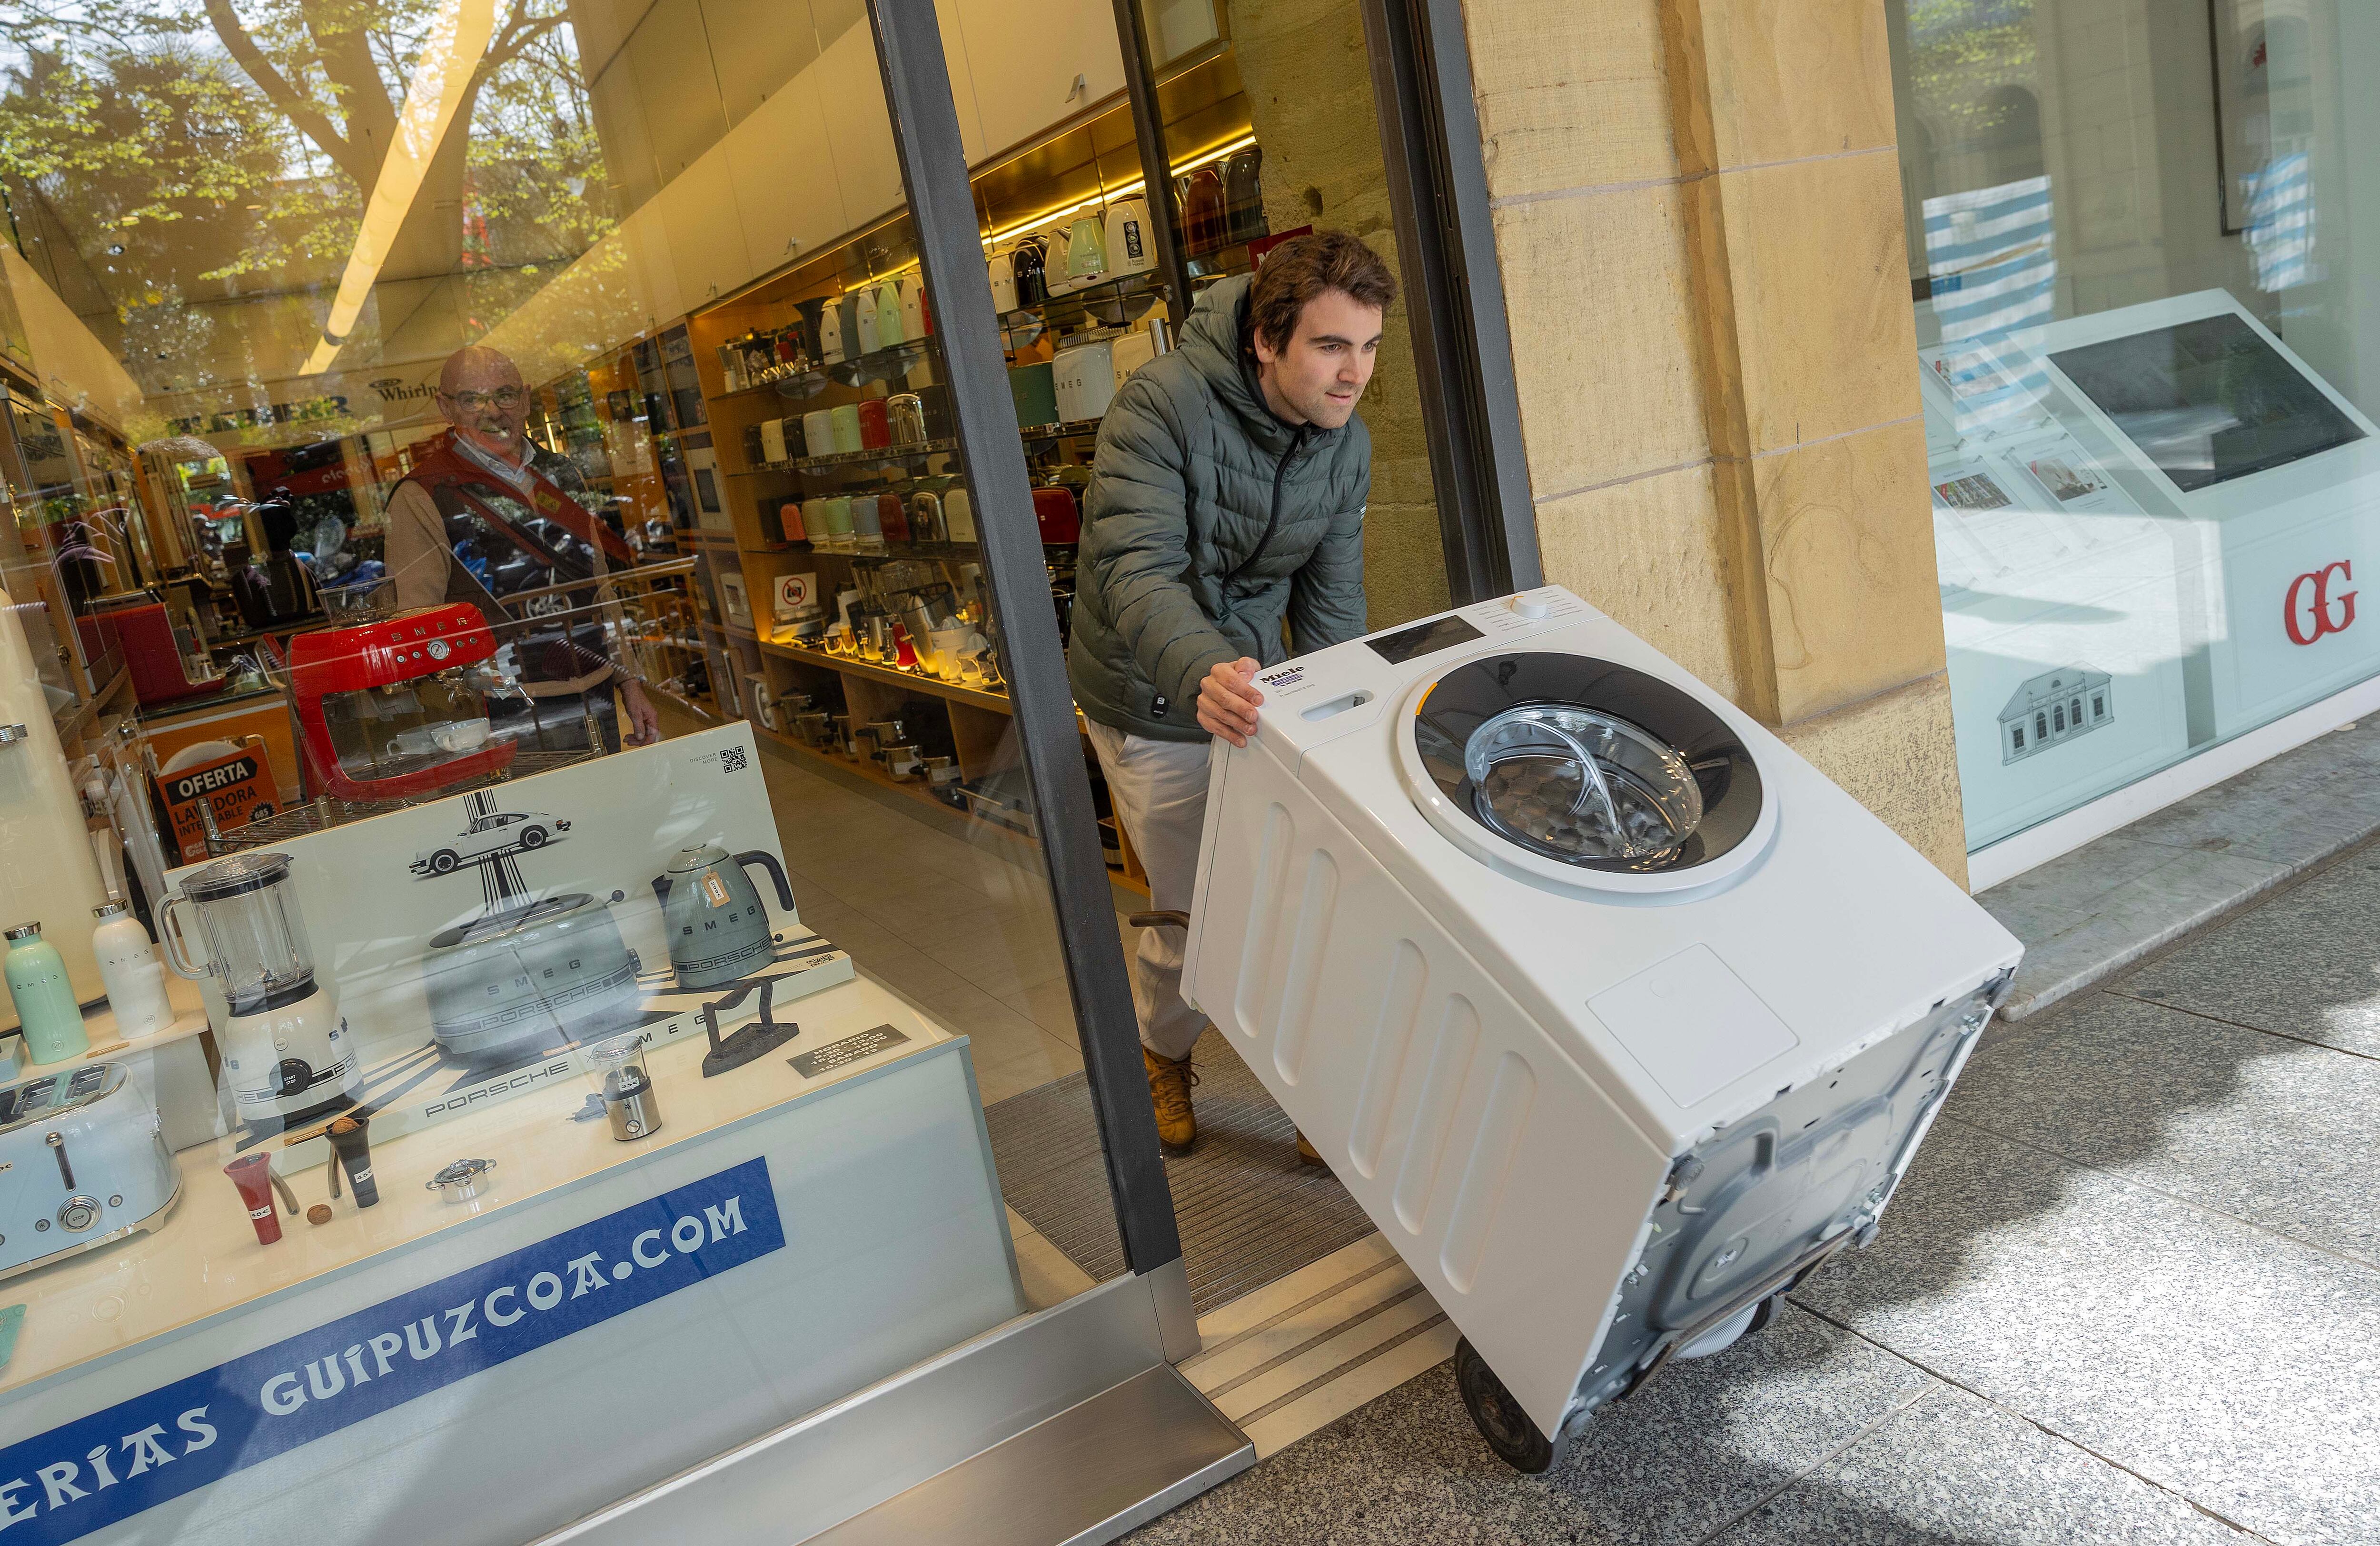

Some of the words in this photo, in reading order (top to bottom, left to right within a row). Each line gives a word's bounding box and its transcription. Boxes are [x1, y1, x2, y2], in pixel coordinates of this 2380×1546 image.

[377, 382, 441, 401] Whirlp
[391, 617, 467, 642] SMEG
[1259, 666, 1305, 684] Miele
[690, 752, 716, 763] DISCOVER
[178, 762, 248, 798] OFERTA
[254, 808, 269, 819] 685
[710, 881, 722, 898] 299€
[683, 905, 756, 935] SMEG
[109, 949, 149, 966] SMEG
[689, 937, 770, 971] PORSCHE
[16, 974, 58, 990] SMEG
[487, 959, 581, 996] SMEG
[483, 982, 603, 1028] PORSCHE
[638, 1014, 705, 1044] MEG
[813, 1033, 869, 1056] HORARIO
[828, 1043, 878, 1064] SABADO
[425, 1060, 569, 1118] PORSCHE
[621, 1080, 638, 1089] 35€
[357, 1168, 372, 1181] 45€
[72, 1214, 85, 1222] STOP
[251, 1208, 269, 1218] 45€
